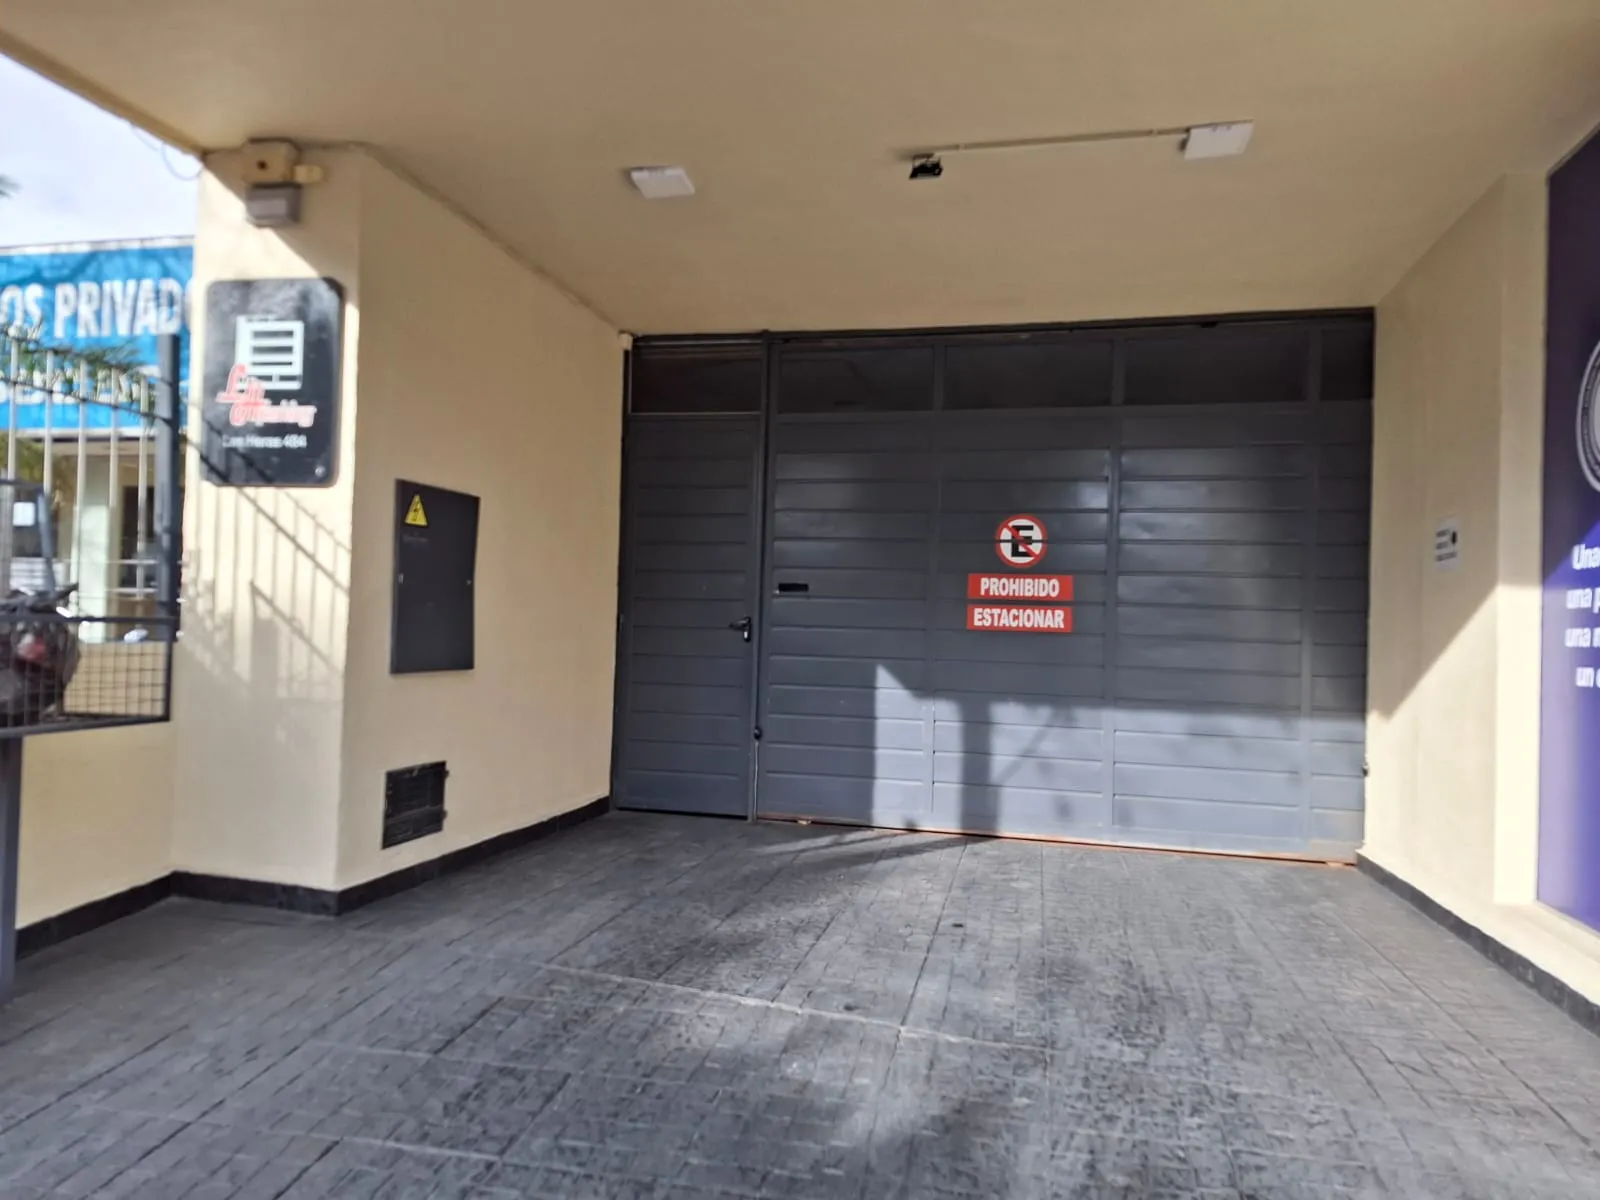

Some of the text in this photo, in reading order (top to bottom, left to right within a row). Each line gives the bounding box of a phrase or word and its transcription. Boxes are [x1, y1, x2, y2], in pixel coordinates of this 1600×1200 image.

[980, 577, 1060, 598] PROHIBIDO
[1566, 587, 1592, 610] una
[973, 608, 1065, 629] ESTACIONAR
[1565, 627, 1591, 648] una
[1576, 666, 1594, 688] un
